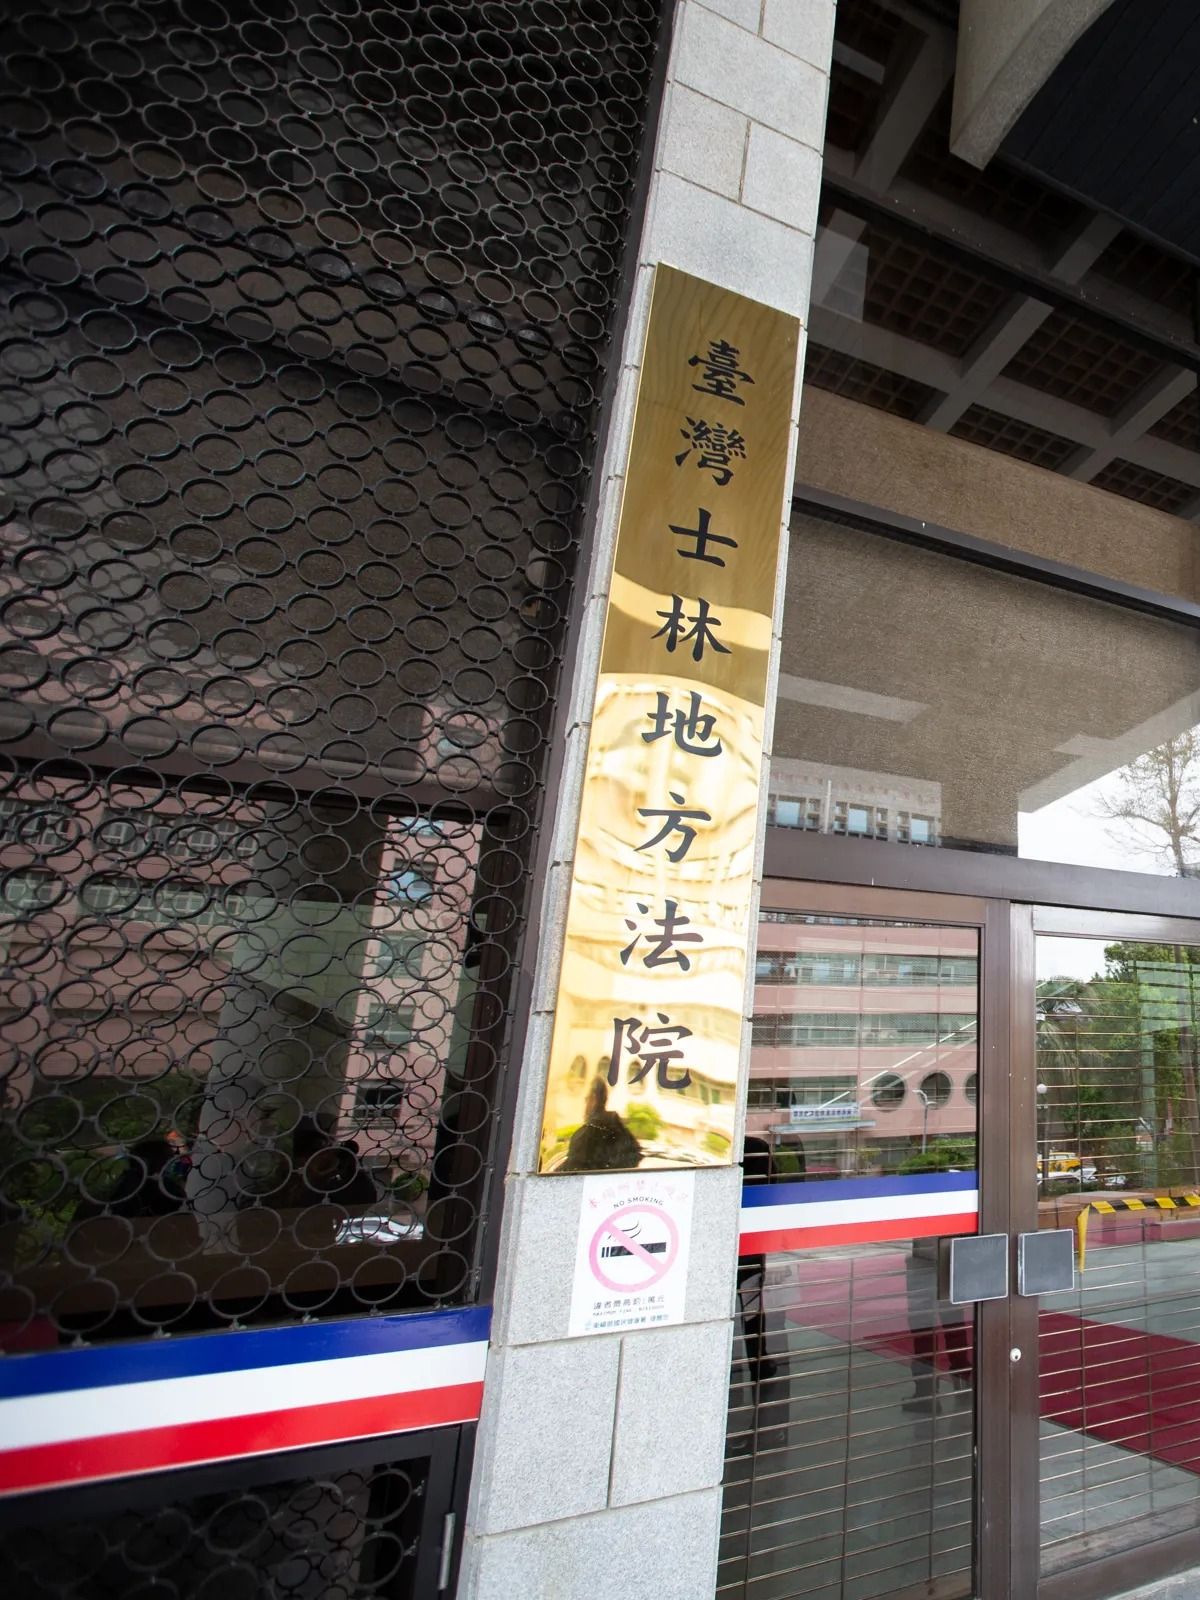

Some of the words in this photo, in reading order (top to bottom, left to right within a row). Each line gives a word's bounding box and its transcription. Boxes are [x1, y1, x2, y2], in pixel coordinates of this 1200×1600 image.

[607, 339, 755, 1090] 臺灣士林地方法院
[613, 1200, 625, 1209] NO
[627, 1196, 664, 1206] SMOKING
